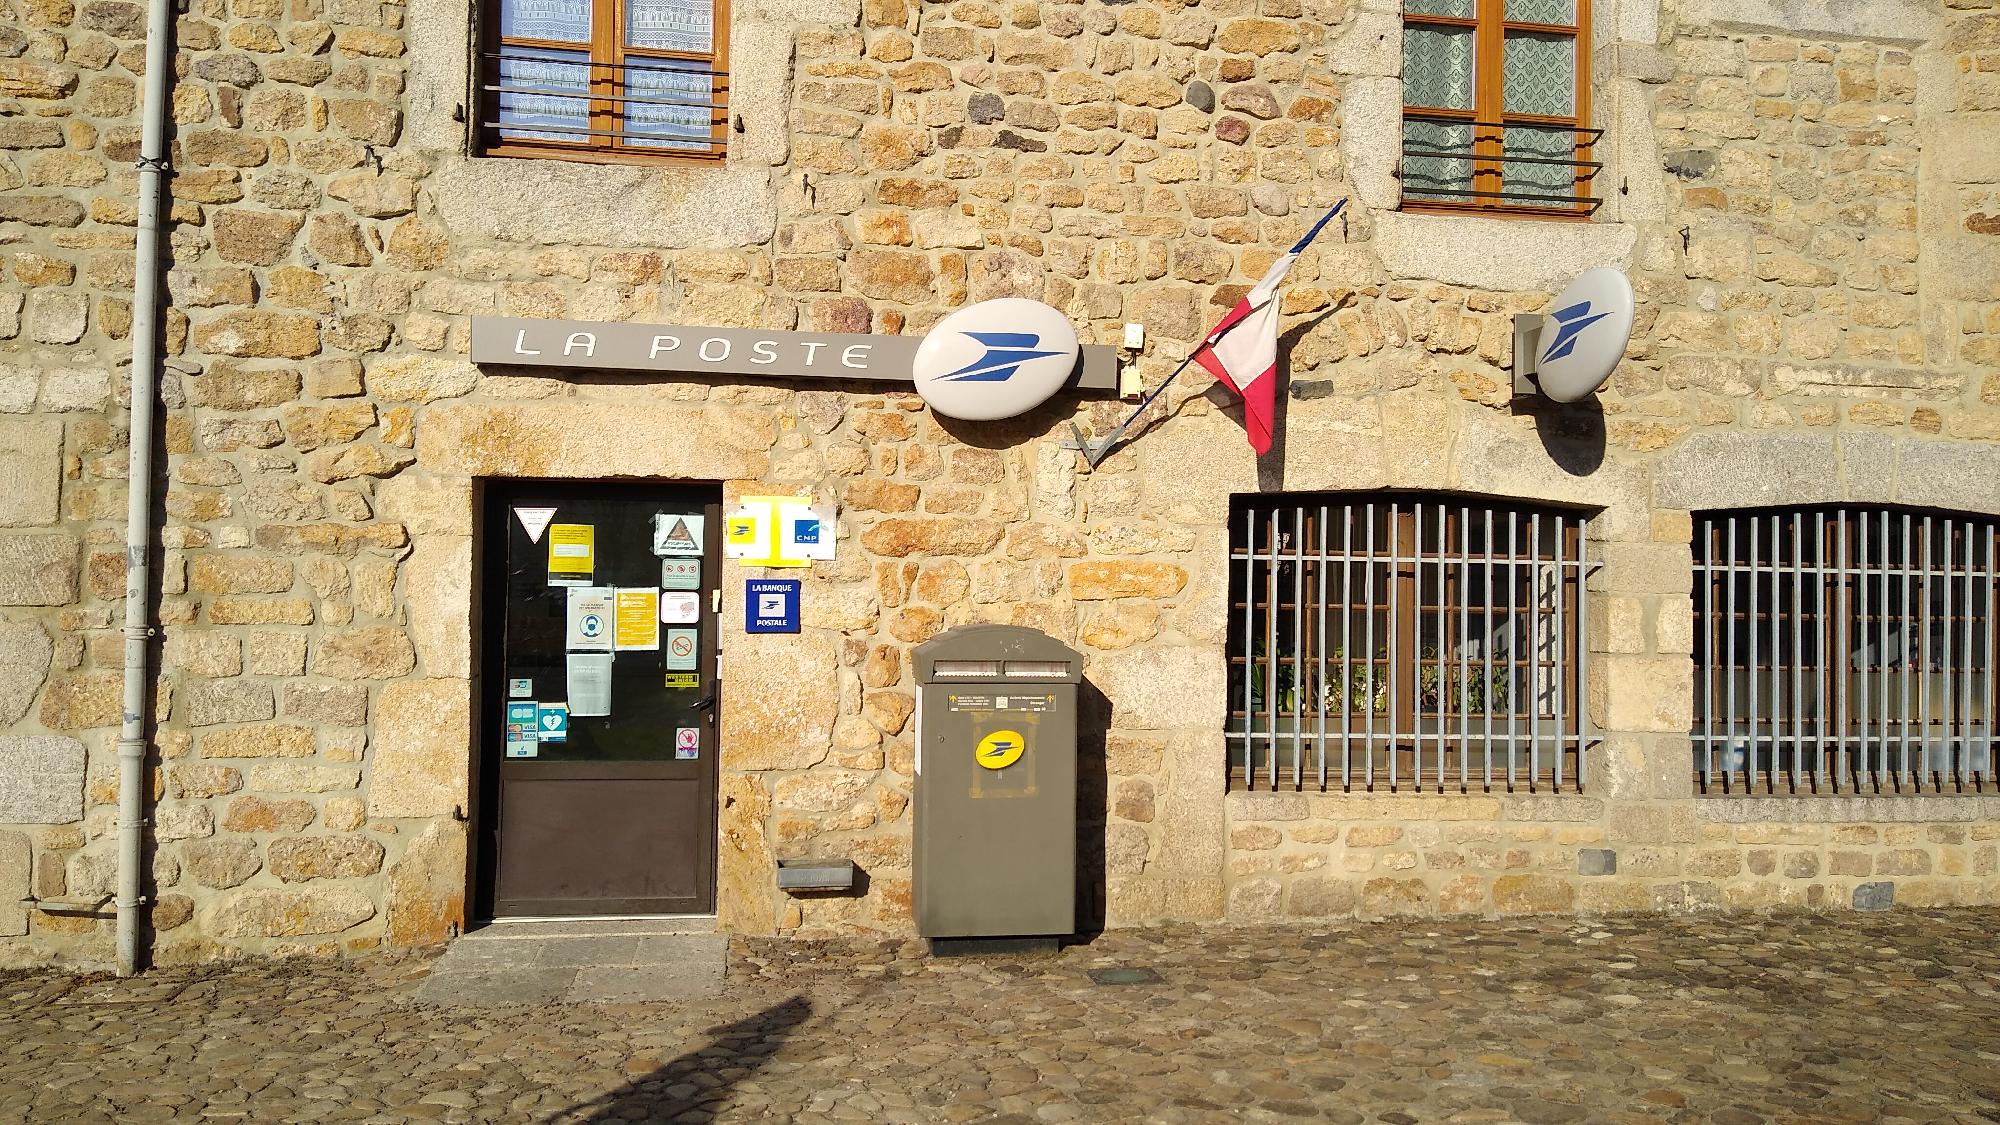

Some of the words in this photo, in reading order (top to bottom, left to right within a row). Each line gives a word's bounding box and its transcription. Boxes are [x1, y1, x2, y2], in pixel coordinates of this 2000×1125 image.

[514, 329, 597, 358] LA
[648, 335, 873, 369] POSTE
[752, 584, 761, 592] LA
[762, 584, 792, 592] BANQUE
[756, 619, 788, 627] POSTALE
